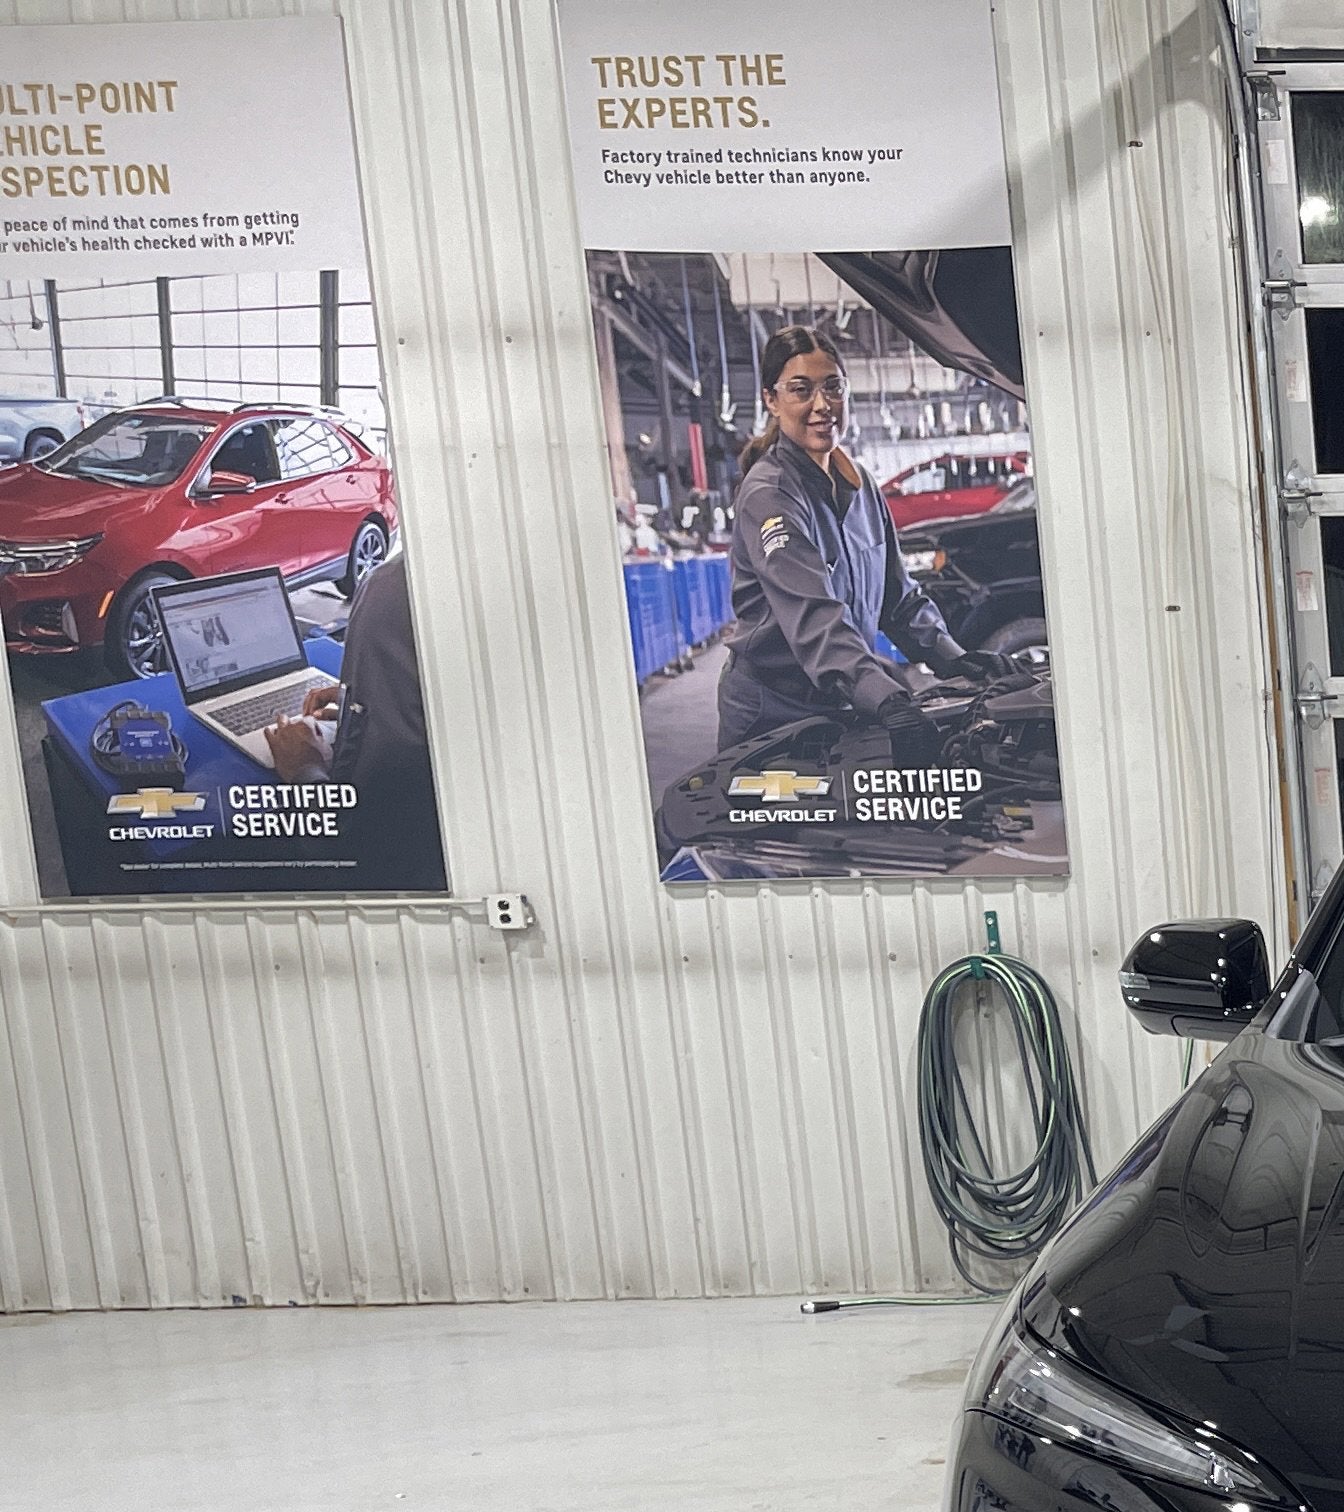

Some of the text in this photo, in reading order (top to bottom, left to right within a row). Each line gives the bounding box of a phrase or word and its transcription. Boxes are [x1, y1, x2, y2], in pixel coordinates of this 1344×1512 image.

[590, 53, 787, 88] TRUST THE
[0, 80, 178, 115] LTI-POINT
[597, 95, 771, 129] EXPERTS.
[0, 124, 106, 156] HICLE
[601, 146, 904, 167] Factory trained technicians know your
[1, 164, 171, 197] SPECTION
[604, 168, 870, 187] Chevy vehicle better than anyone.
[4, 210, 299, 236] peace of mind that comes from getting
[13, 236, 77, 252] vehicle's
[82, 236, 128, 251] health
[134, 235, 196, 250] checked
[201, 233, 234, 249] with
[240, 236, 247, 247] a
[852, 768, 983, 794] CERTIFIED
[228, 784, 358, 809] CERTIFIED
[855, 796, 963, 822] SERVICE
[232, 812, 339, 837] SERVICE
[729, 808, 837, 823] CHEVROLET
[108, 824, 215, 841] CHEVROLET
